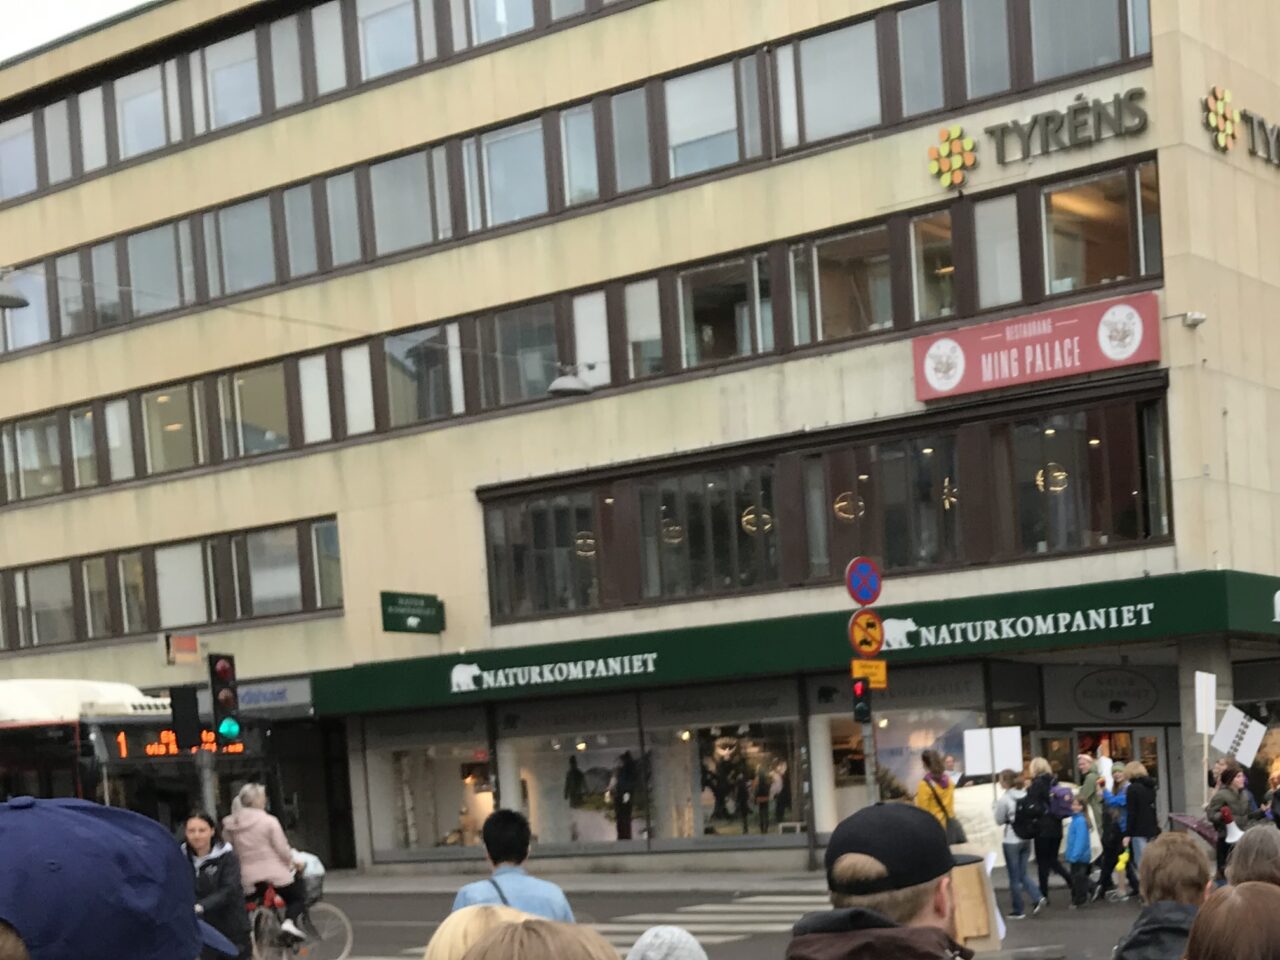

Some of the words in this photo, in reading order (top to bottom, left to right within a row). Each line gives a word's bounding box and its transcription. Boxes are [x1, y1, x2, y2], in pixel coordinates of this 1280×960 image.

[985, 87, 1148, 165] TYRÉNS
[982, 347, 1019, 382] MING
[1025, 336, 1080, 374] PALACE
[919, 602, 1155, 648] NATURKOMPANIET
[482, 652, 658, 689] NATURKOMPANIET
[117, 731, 128, 759] 1
